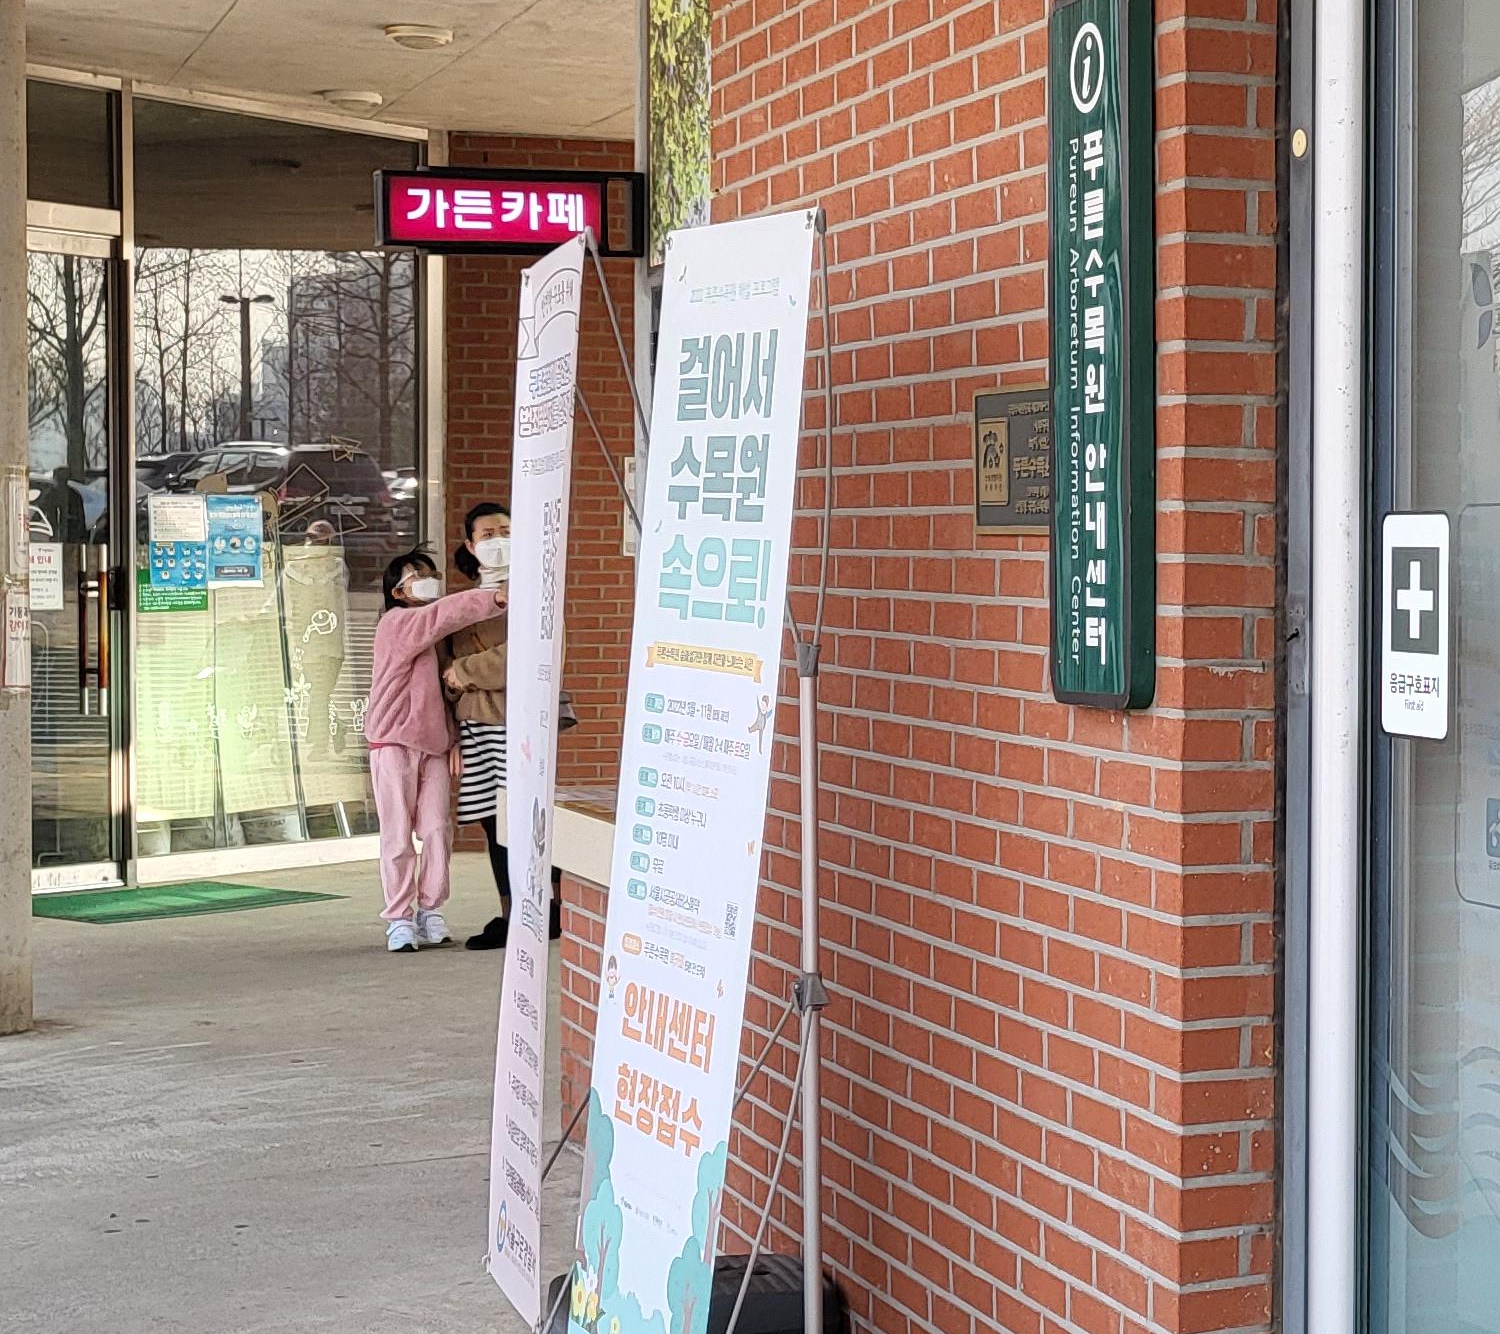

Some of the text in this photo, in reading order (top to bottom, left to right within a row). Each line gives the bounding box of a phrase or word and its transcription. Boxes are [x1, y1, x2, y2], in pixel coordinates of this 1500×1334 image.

[407, 188, 584, 231] 가든카페
[676, 328, 779, 422] 걸어서
[1068, 137, 1083, 666] Pureun Arboretum Information Center
[1083, 129, 1107, 666] 푸른수목원 안내센터
[667, 433, 770, 522] 수목원
[658, 534, 772, 630] 속으로!
[1390, 673, 1440, 698] 응급구호표지
[622, 982, 715, 1074] 안내센터
[614, 1062, 703, 1157] 현장접수
